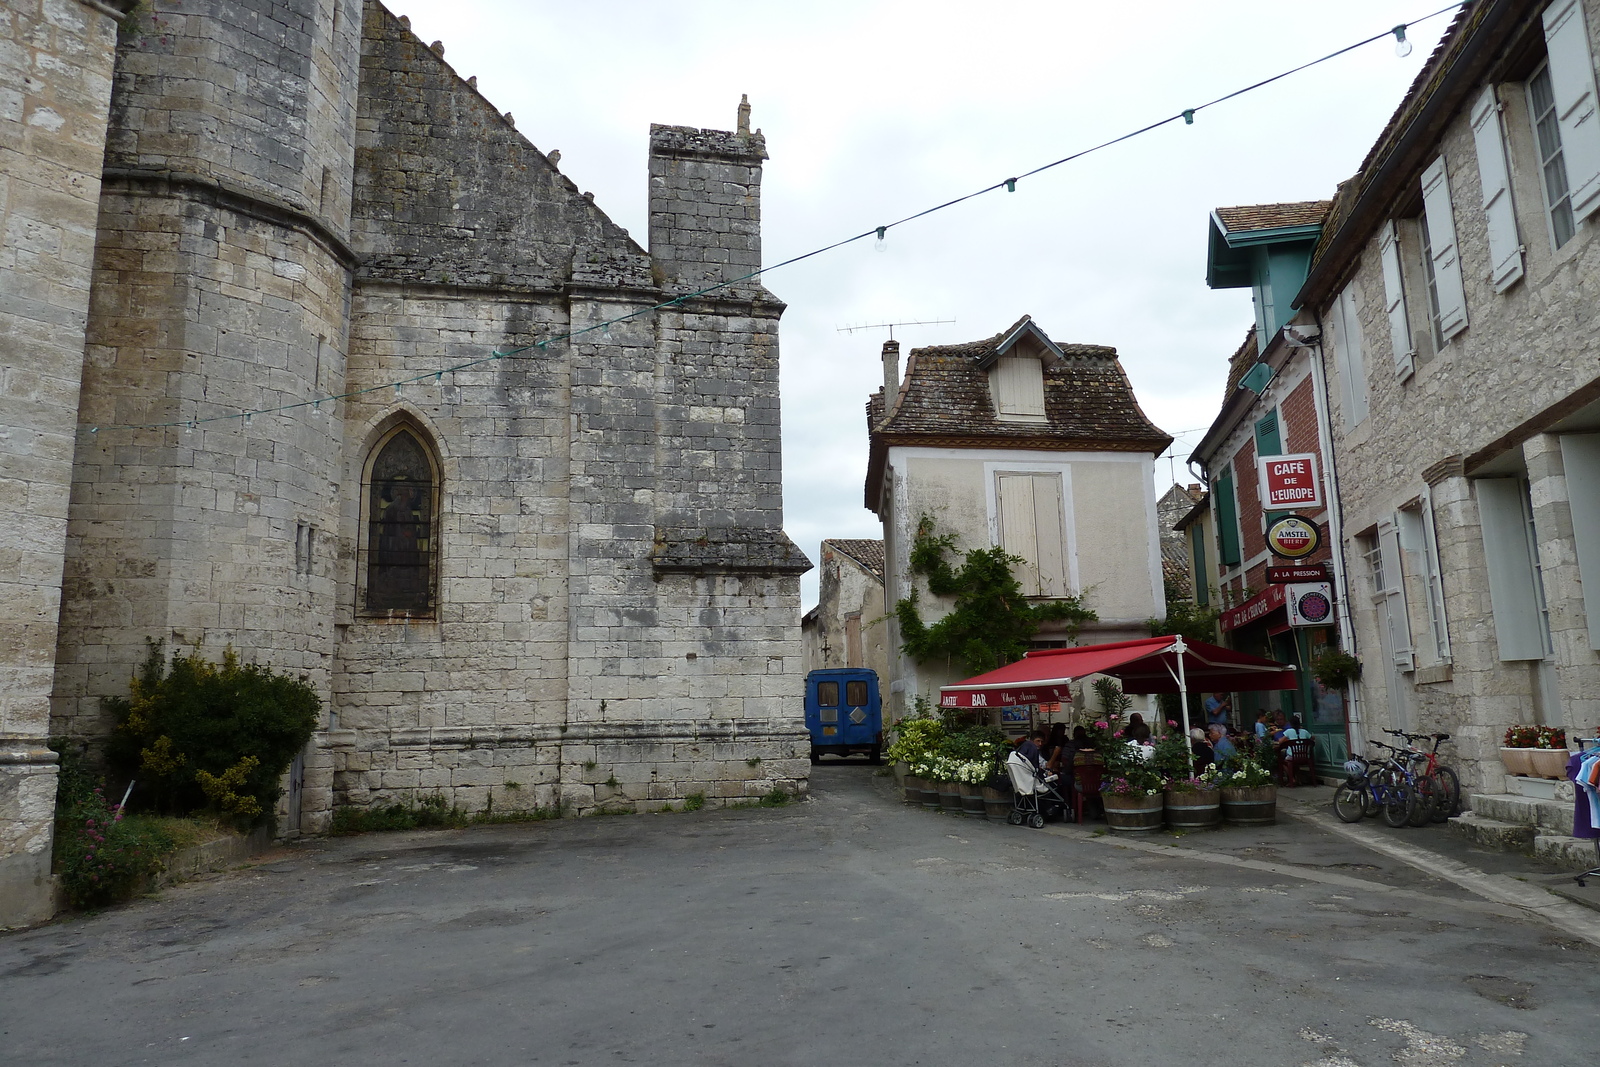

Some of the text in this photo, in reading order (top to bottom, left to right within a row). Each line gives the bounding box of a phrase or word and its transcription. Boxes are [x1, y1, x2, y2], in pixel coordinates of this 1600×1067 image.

[1274, 461, 1305, 476] CAFÉ
[1284, 477, 1298, 485] DE
[1271, 487, 1314, 501] L'EUROPE
[1278, 530, 1309, 538] AMSTEL
[971, 693, 987, 707] BAR
